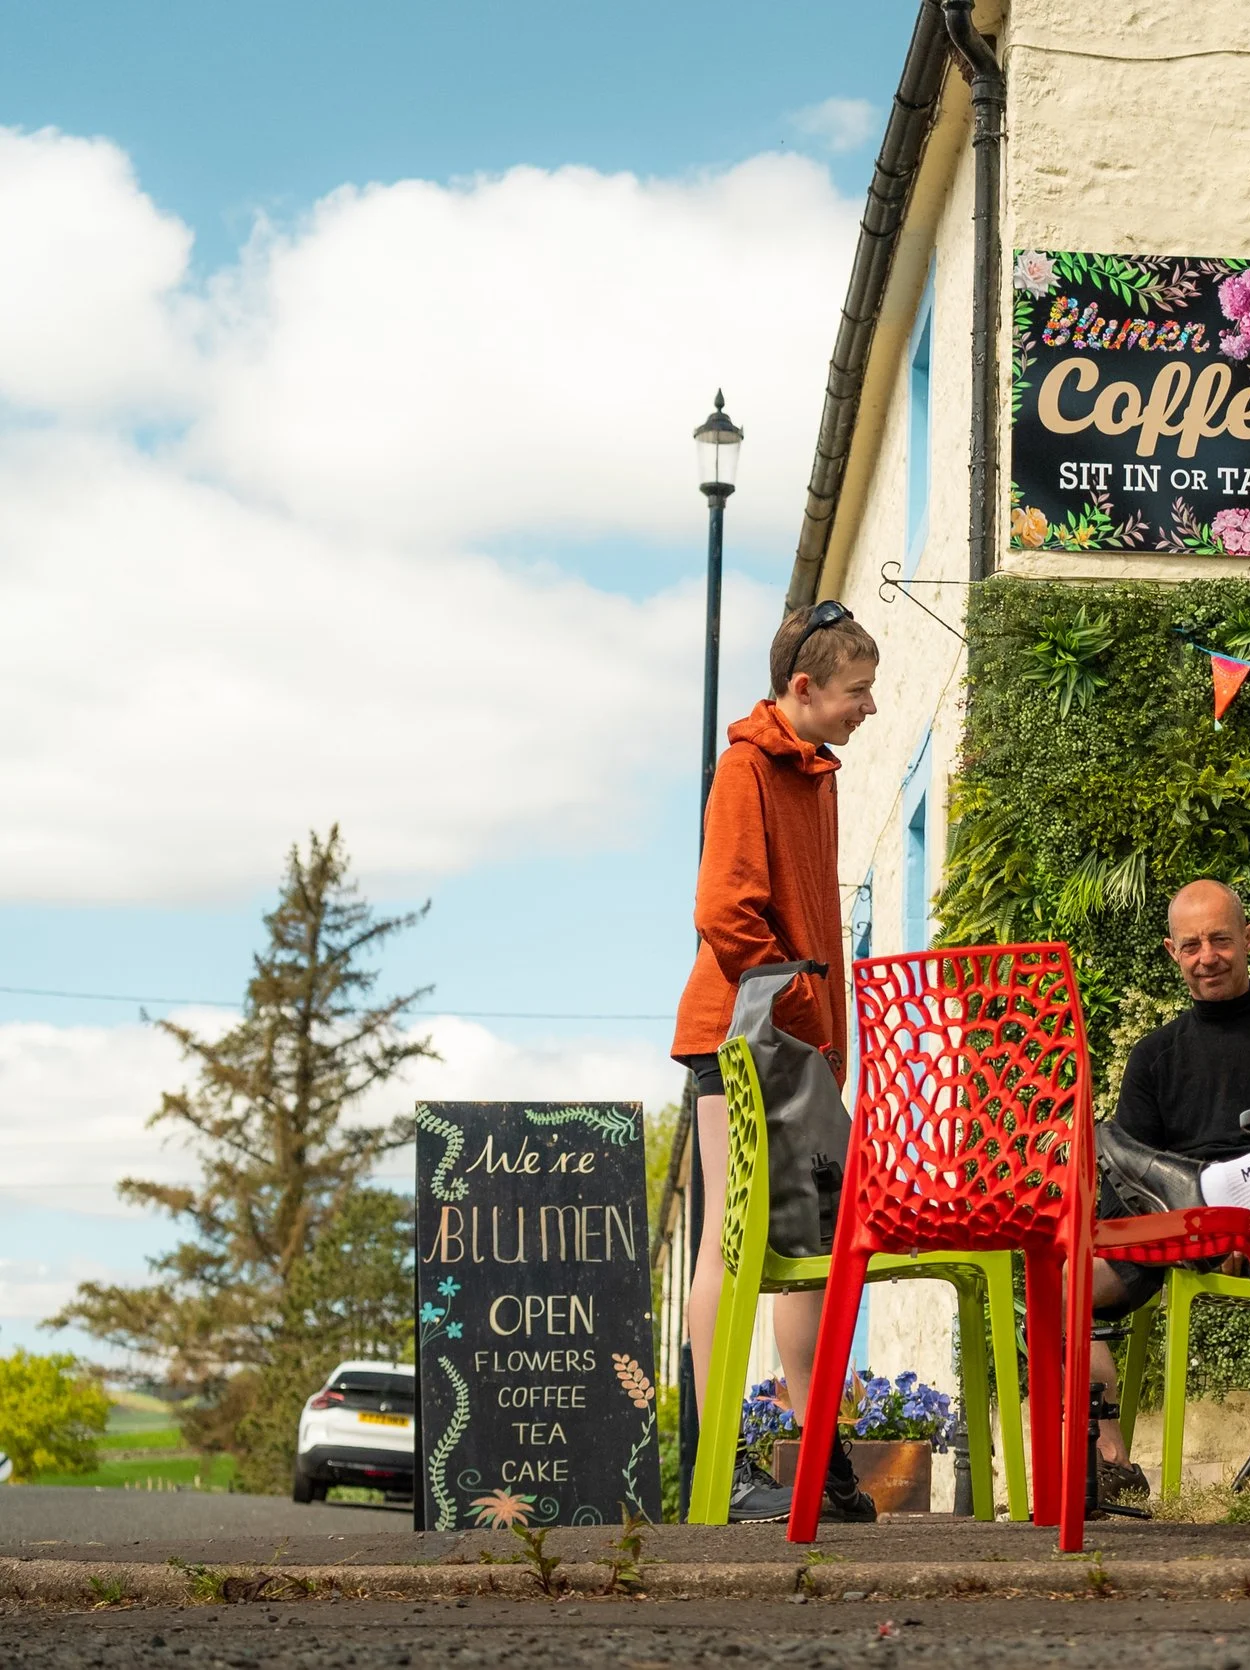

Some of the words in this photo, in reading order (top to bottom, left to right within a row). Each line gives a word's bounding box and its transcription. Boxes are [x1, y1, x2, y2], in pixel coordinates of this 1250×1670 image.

[1042, 296, 1210, 353] Blumen
[1059, 462, 1112, 491] SIT
[1123, 464, 1160, 492] IN
[1170, 469, 1207, 490] OR
[466, 1134, 595, 1174] We're
[489, 1295, 593, 1335] OPEN
[475, 1349, 596, 1372] FLOWERS
[498, 1386, 586, 1408] COFFEE
[512, 1422, 567, 1445] TEA
[502, 1460, 568, 1482] CAKE
